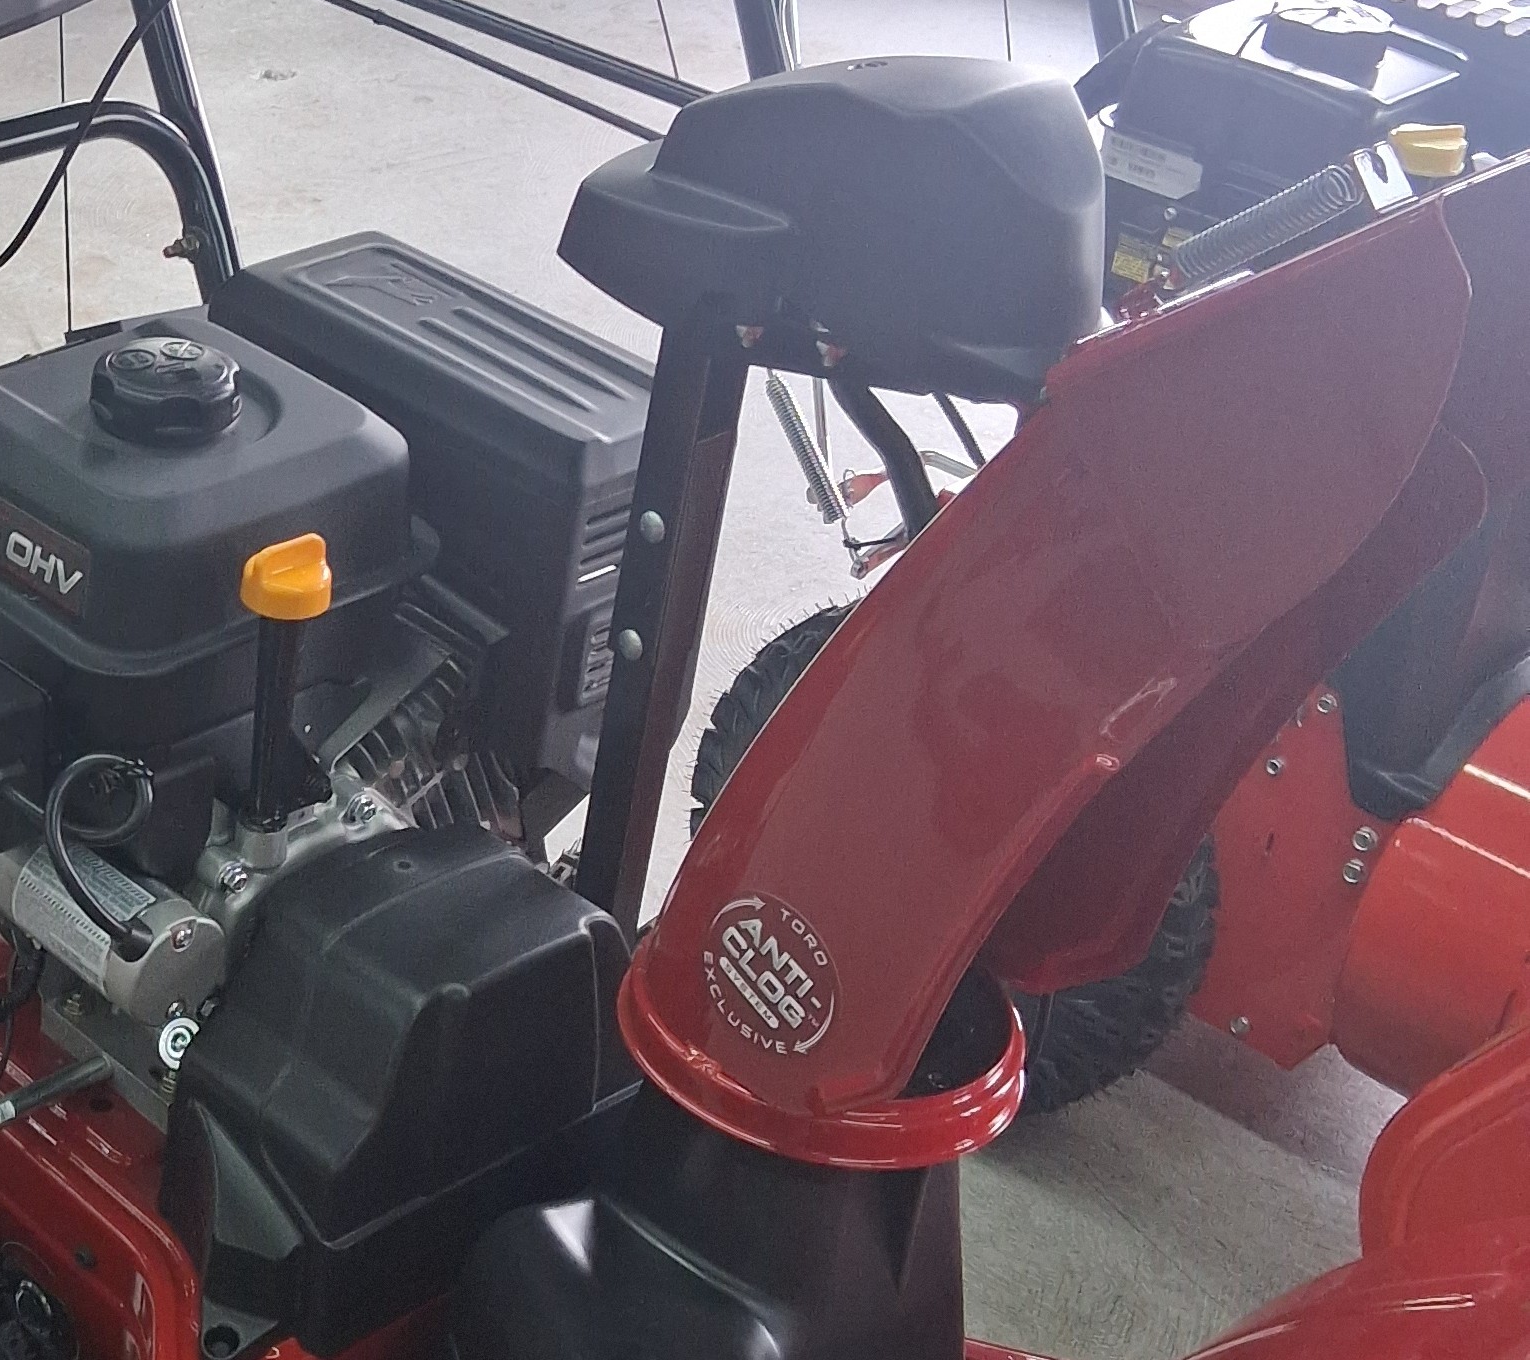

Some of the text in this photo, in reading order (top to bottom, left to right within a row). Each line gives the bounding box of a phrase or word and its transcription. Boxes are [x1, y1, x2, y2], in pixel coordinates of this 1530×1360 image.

[5, 531, 84, 596] OHV
[780, 907, 829, 967] TORO
[703, 950, 788, 1055] EXCLUSIVE
[721, 925, 806, 1030] CLOG
[724, 962, 774, 1021] SYSTEM
